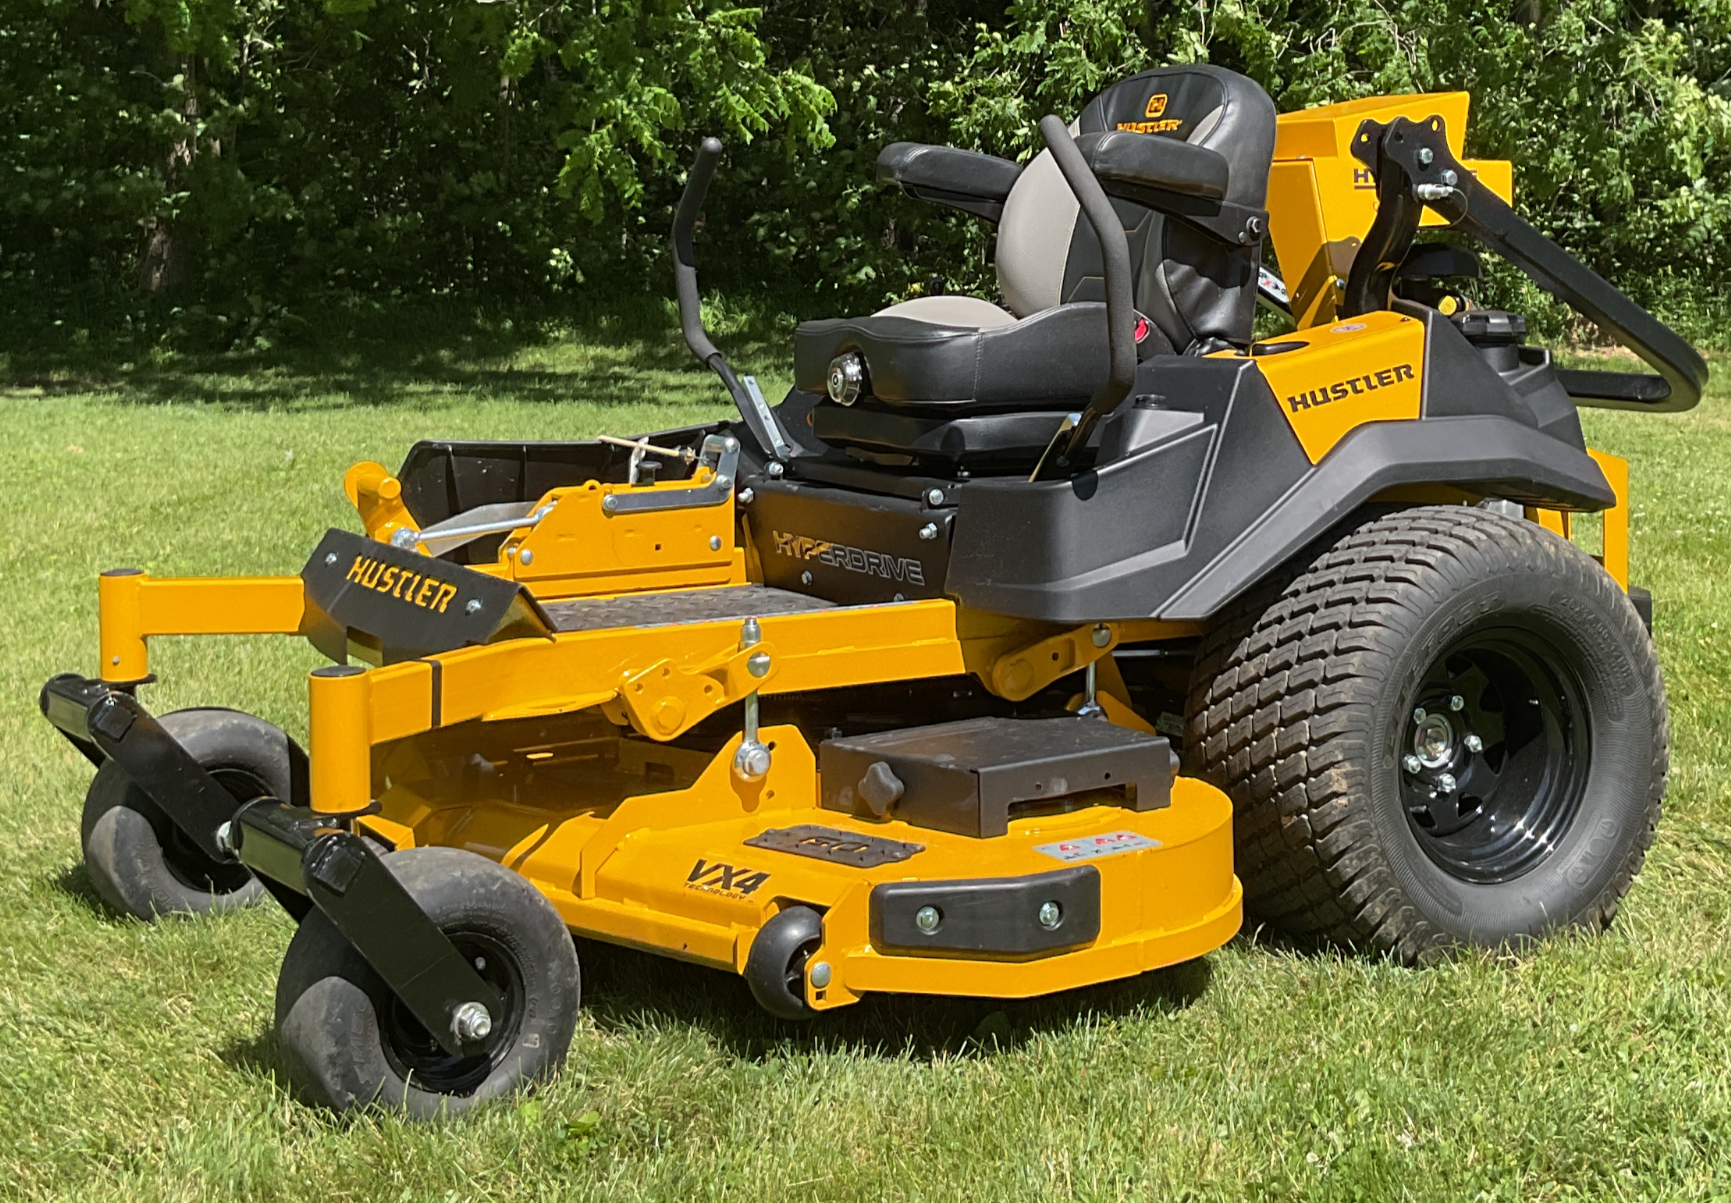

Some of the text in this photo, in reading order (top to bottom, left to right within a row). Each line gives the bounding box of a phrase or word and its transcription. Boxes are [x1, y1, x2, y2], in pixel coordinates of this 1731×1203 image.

[1117, 119, 1182, 134] HUSTLER
[1287, 364, 1415, 413] HUSTLER
[773, 530, 925, 586] HYPERDRIVE
[346, 555, 457, 614] HUSTLER
[684, 882, 747, 900] TECHNOLOGY
[687, 858, 771, 895] VX4
